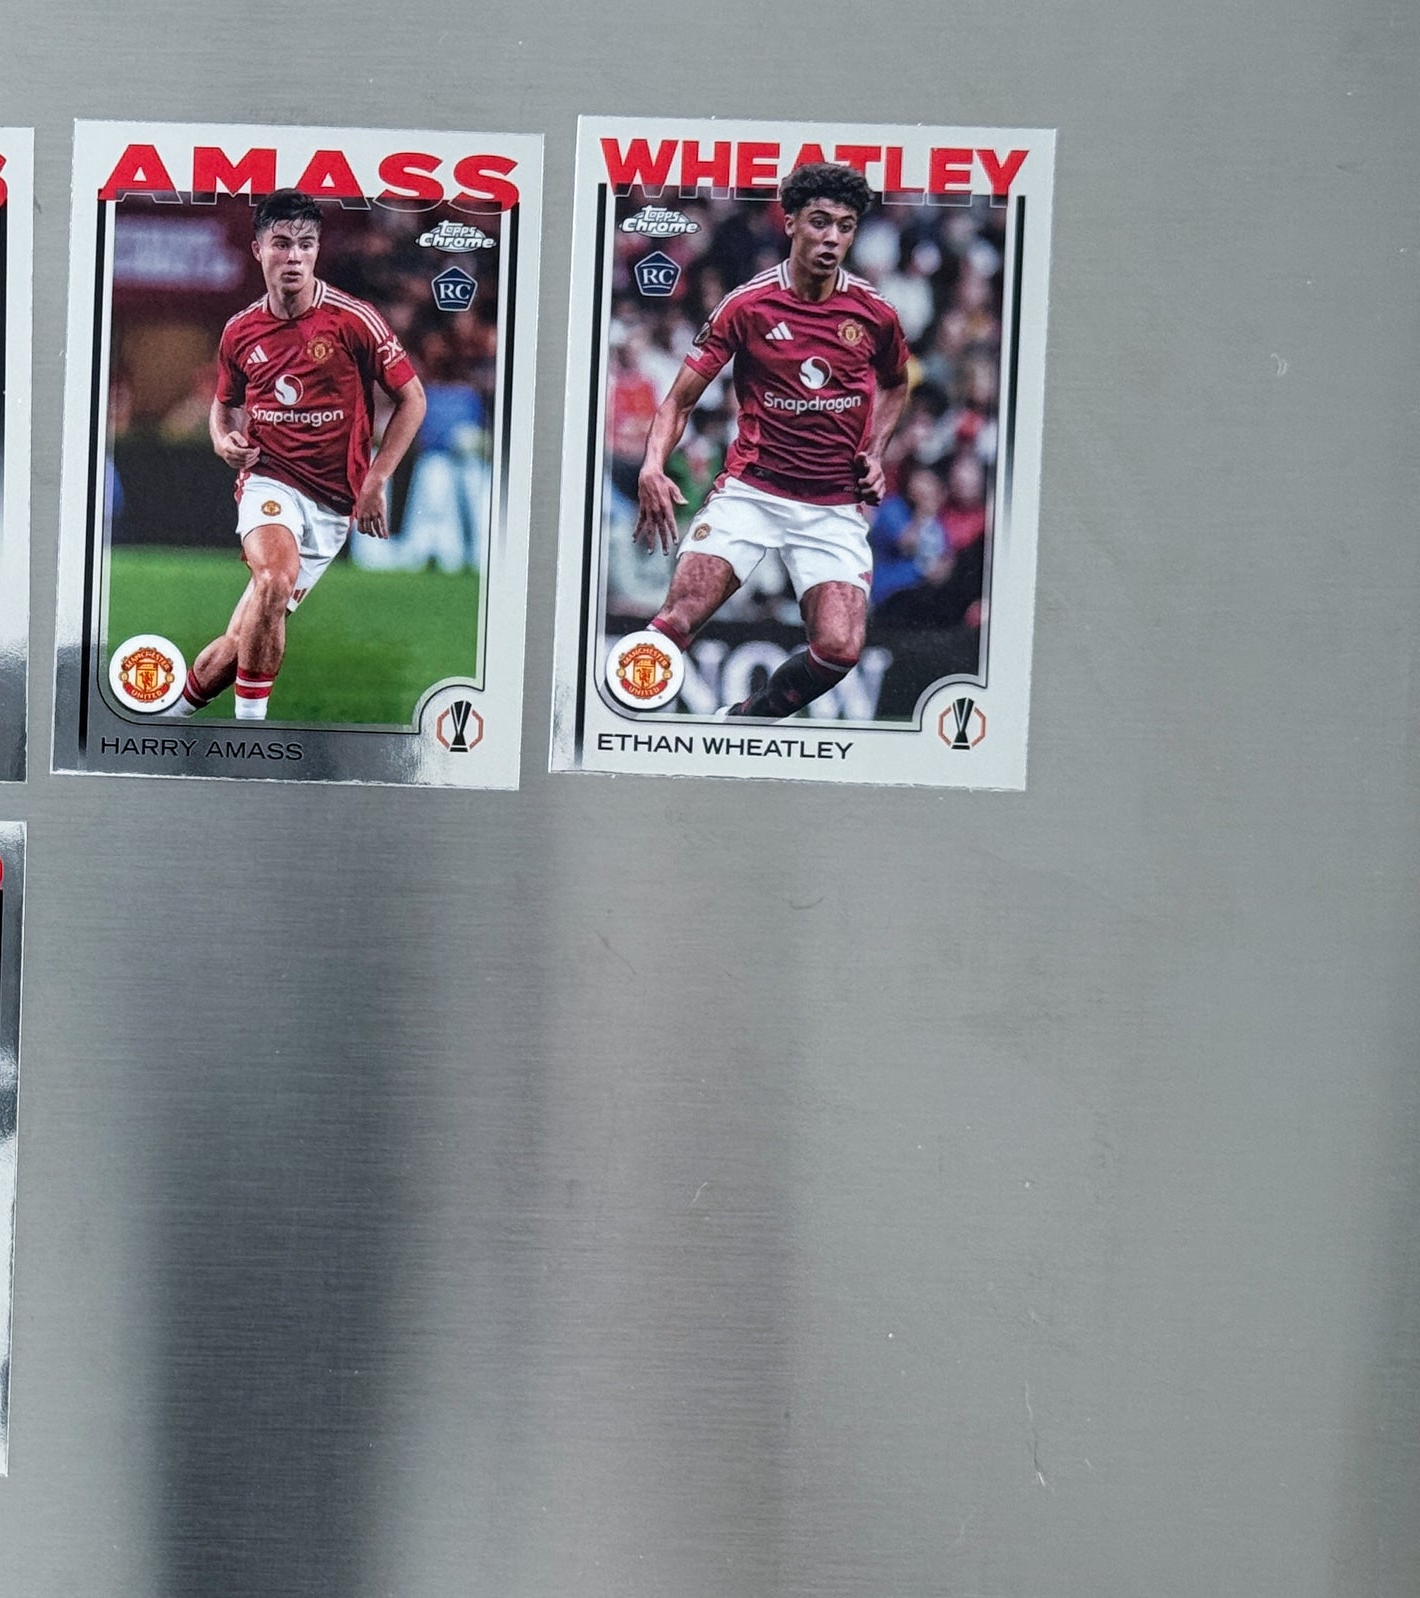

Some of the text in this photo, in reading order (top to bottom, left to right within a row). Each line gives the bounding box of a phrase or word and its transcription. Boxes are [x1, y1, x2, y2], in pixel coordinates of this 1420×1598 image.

[97, 144, 519, 215] AMASS
[622, 218, 698, 233] Chrome
[419, 232, 495, 248] Chrome
[642, 268, 675, 285] RC
[439, 283, 471, 300] RC
[763, 391, 861, 415] Snapdragon
[252, 404, 344, 427] Snapdragon
[101, 737, 303, 760] HARRY AMASS
[597, 733, 854, 759] ETHAN WHEATLEY
